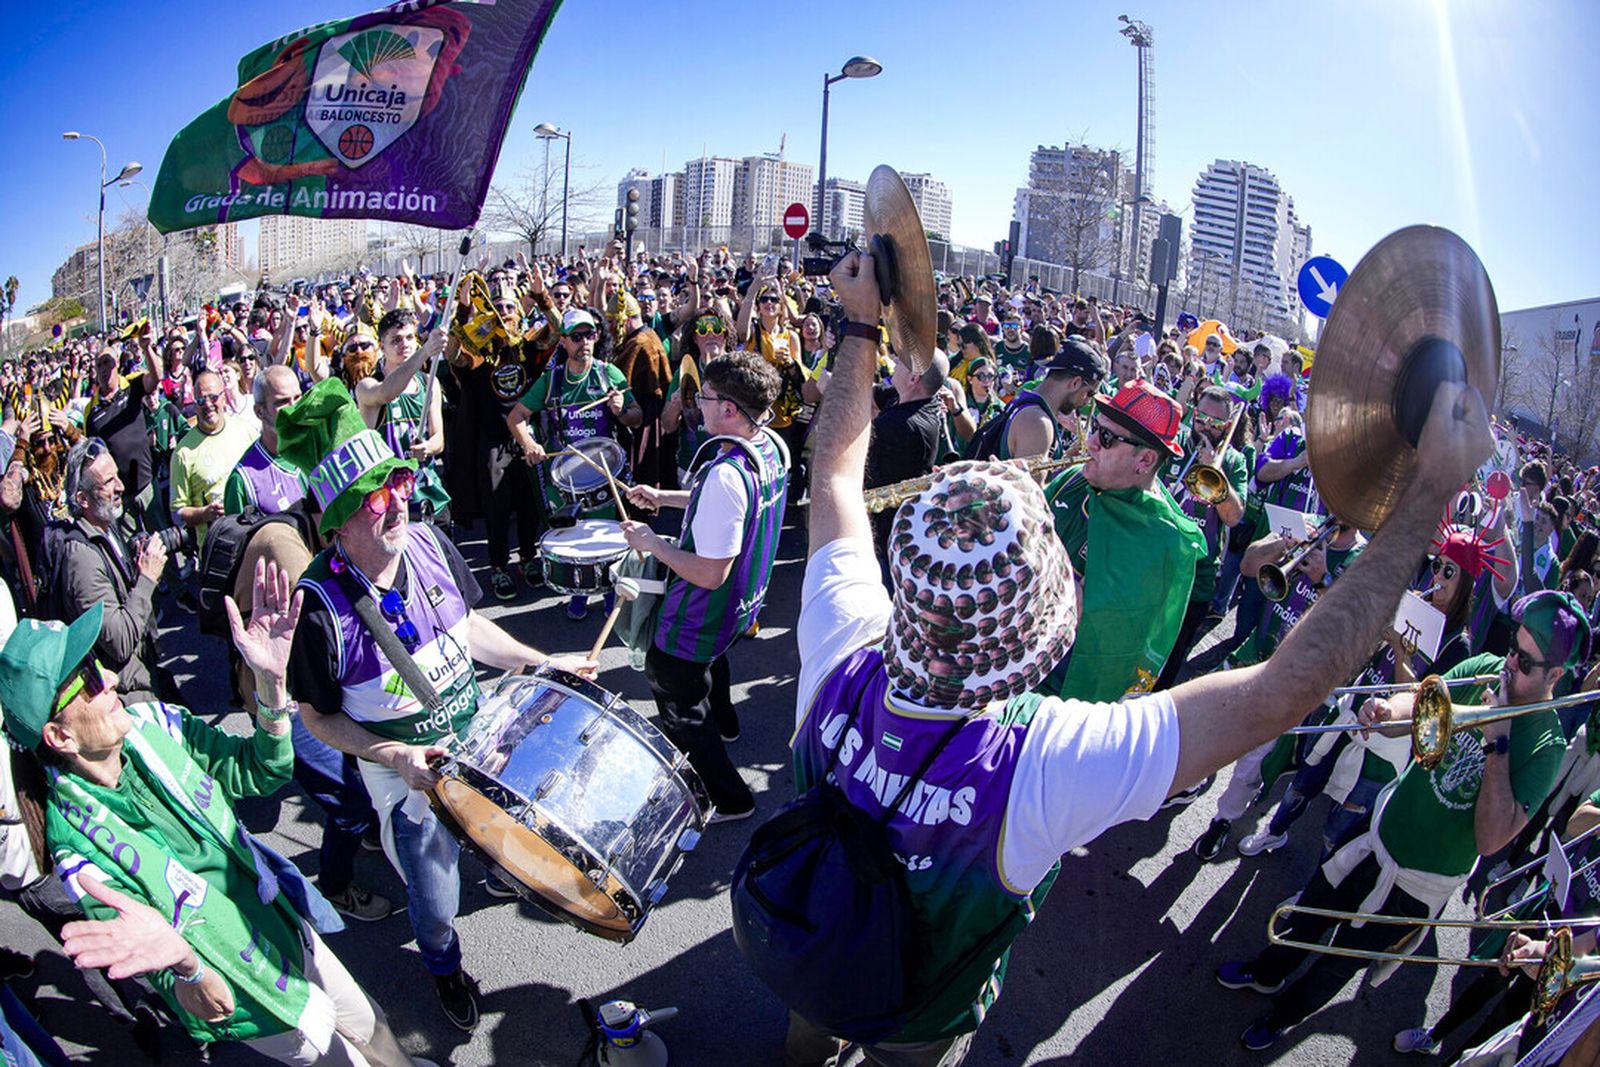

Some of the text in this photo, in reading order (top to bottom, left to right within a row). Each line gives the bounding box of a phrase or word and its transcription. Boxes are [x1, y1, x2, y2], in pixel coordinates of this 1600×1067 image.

[325, 82, 406, 109] Unicaja
[320, 109, 402, 124] BALONCESTO
[255, 186, 285, 207] de
[292, 184, 437, 212] Animación
[1272, 602, 1299, 626] mála
